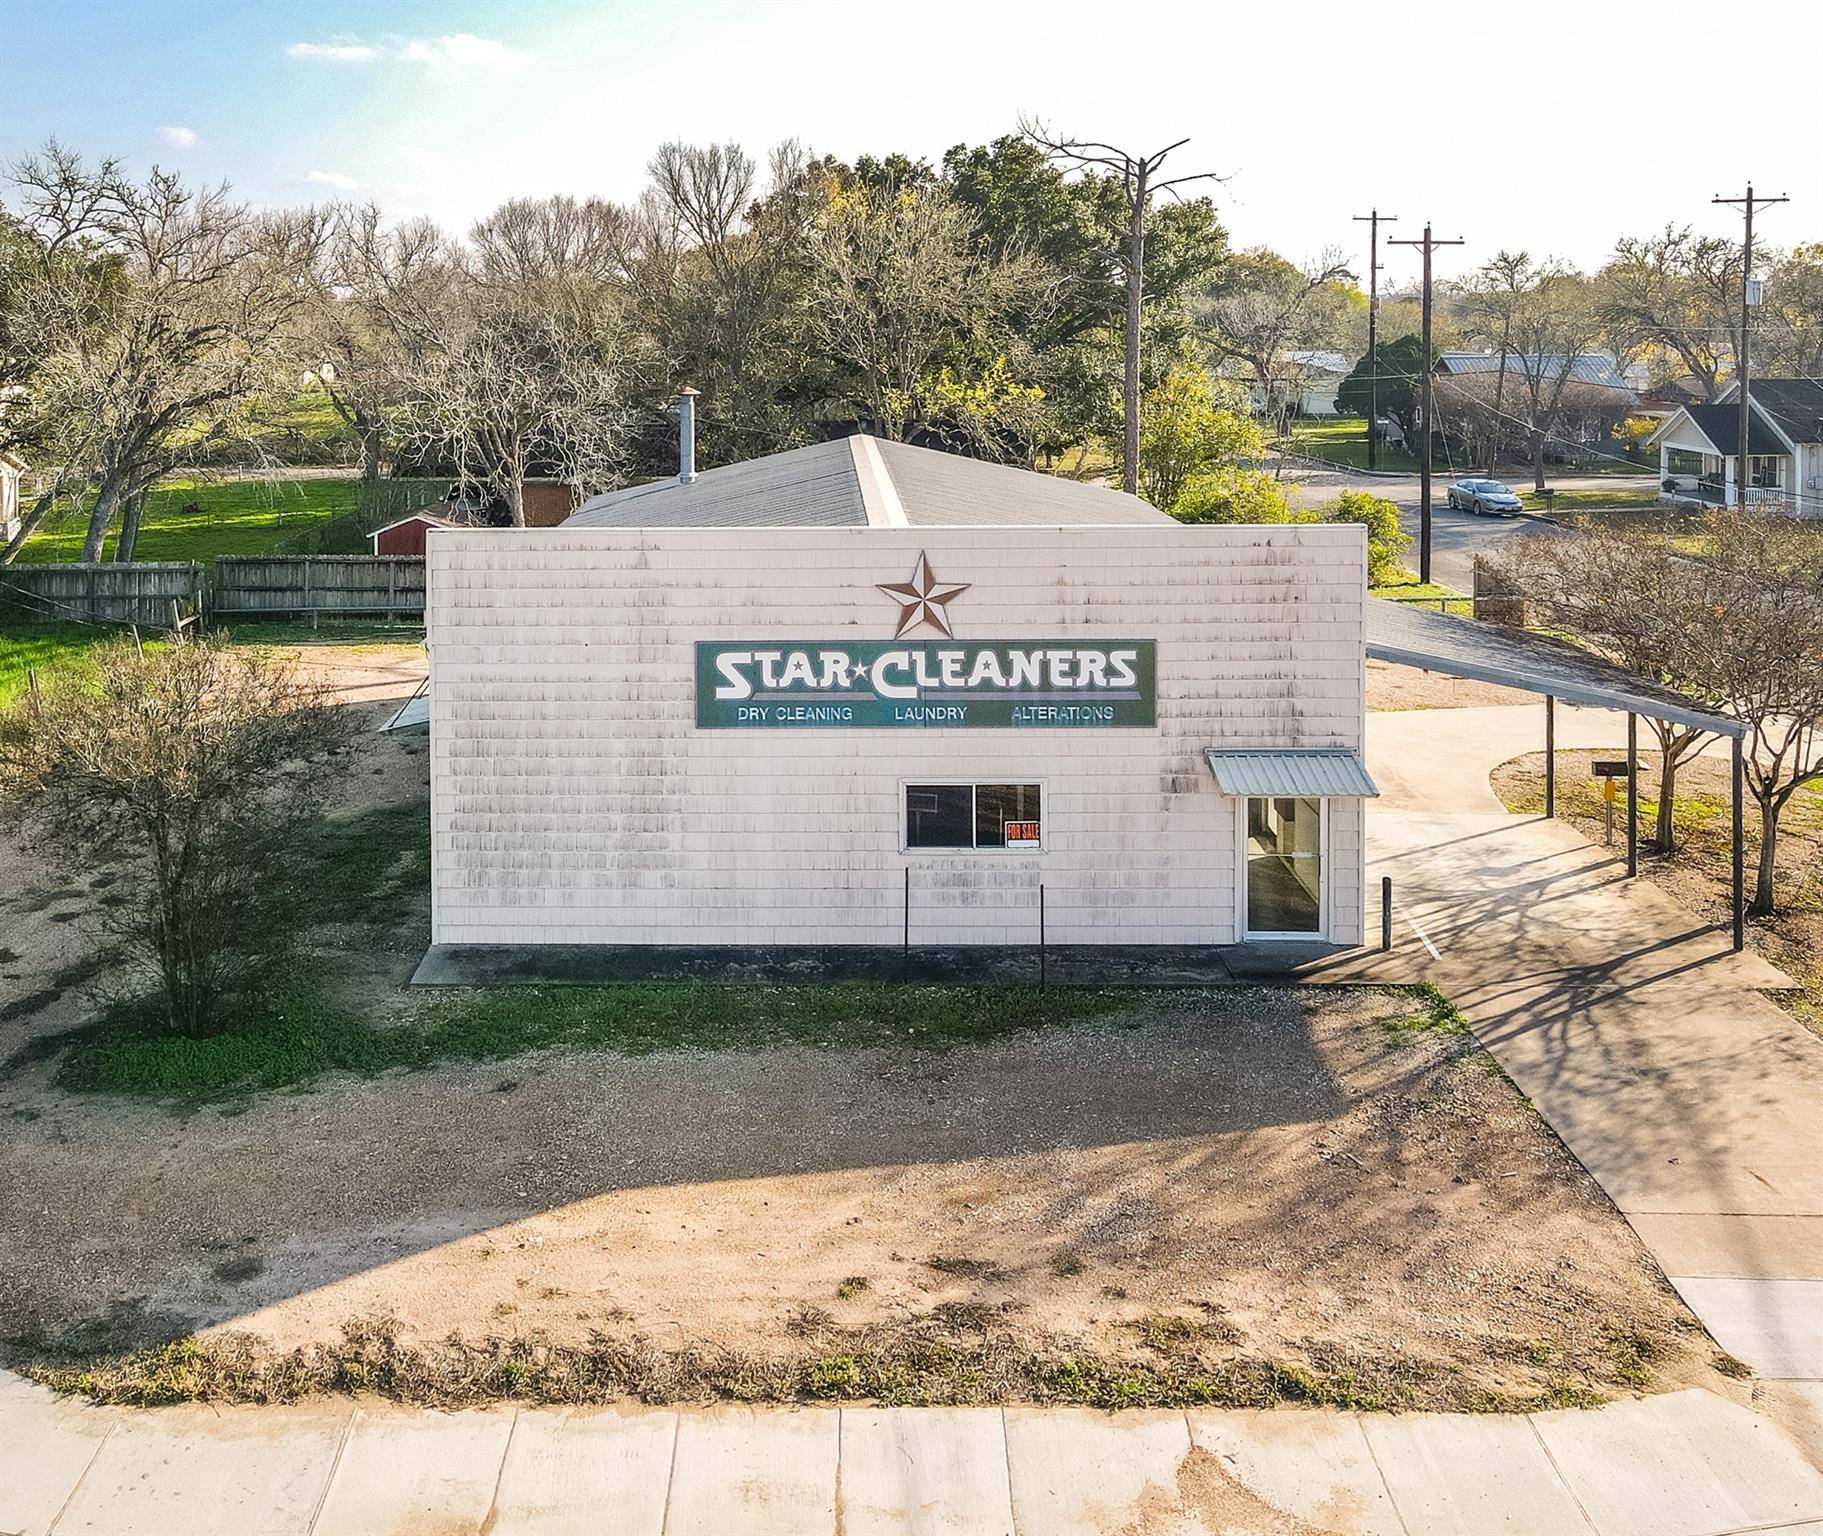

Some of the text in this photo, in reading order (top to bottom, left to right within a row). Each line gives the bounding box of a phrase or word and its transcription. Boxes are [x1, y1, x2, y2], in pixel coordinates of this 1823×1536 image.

[715, 651, 1137, 699] STAR CLEANERS
[738, 707, 853, 721] DRY CLEANING
[895, 706, 968, 720] LAUNDRY
[1011, 706, 1114, 720] ALTERATIONS
[1007, 823, 1039, 839] FOR SALE
